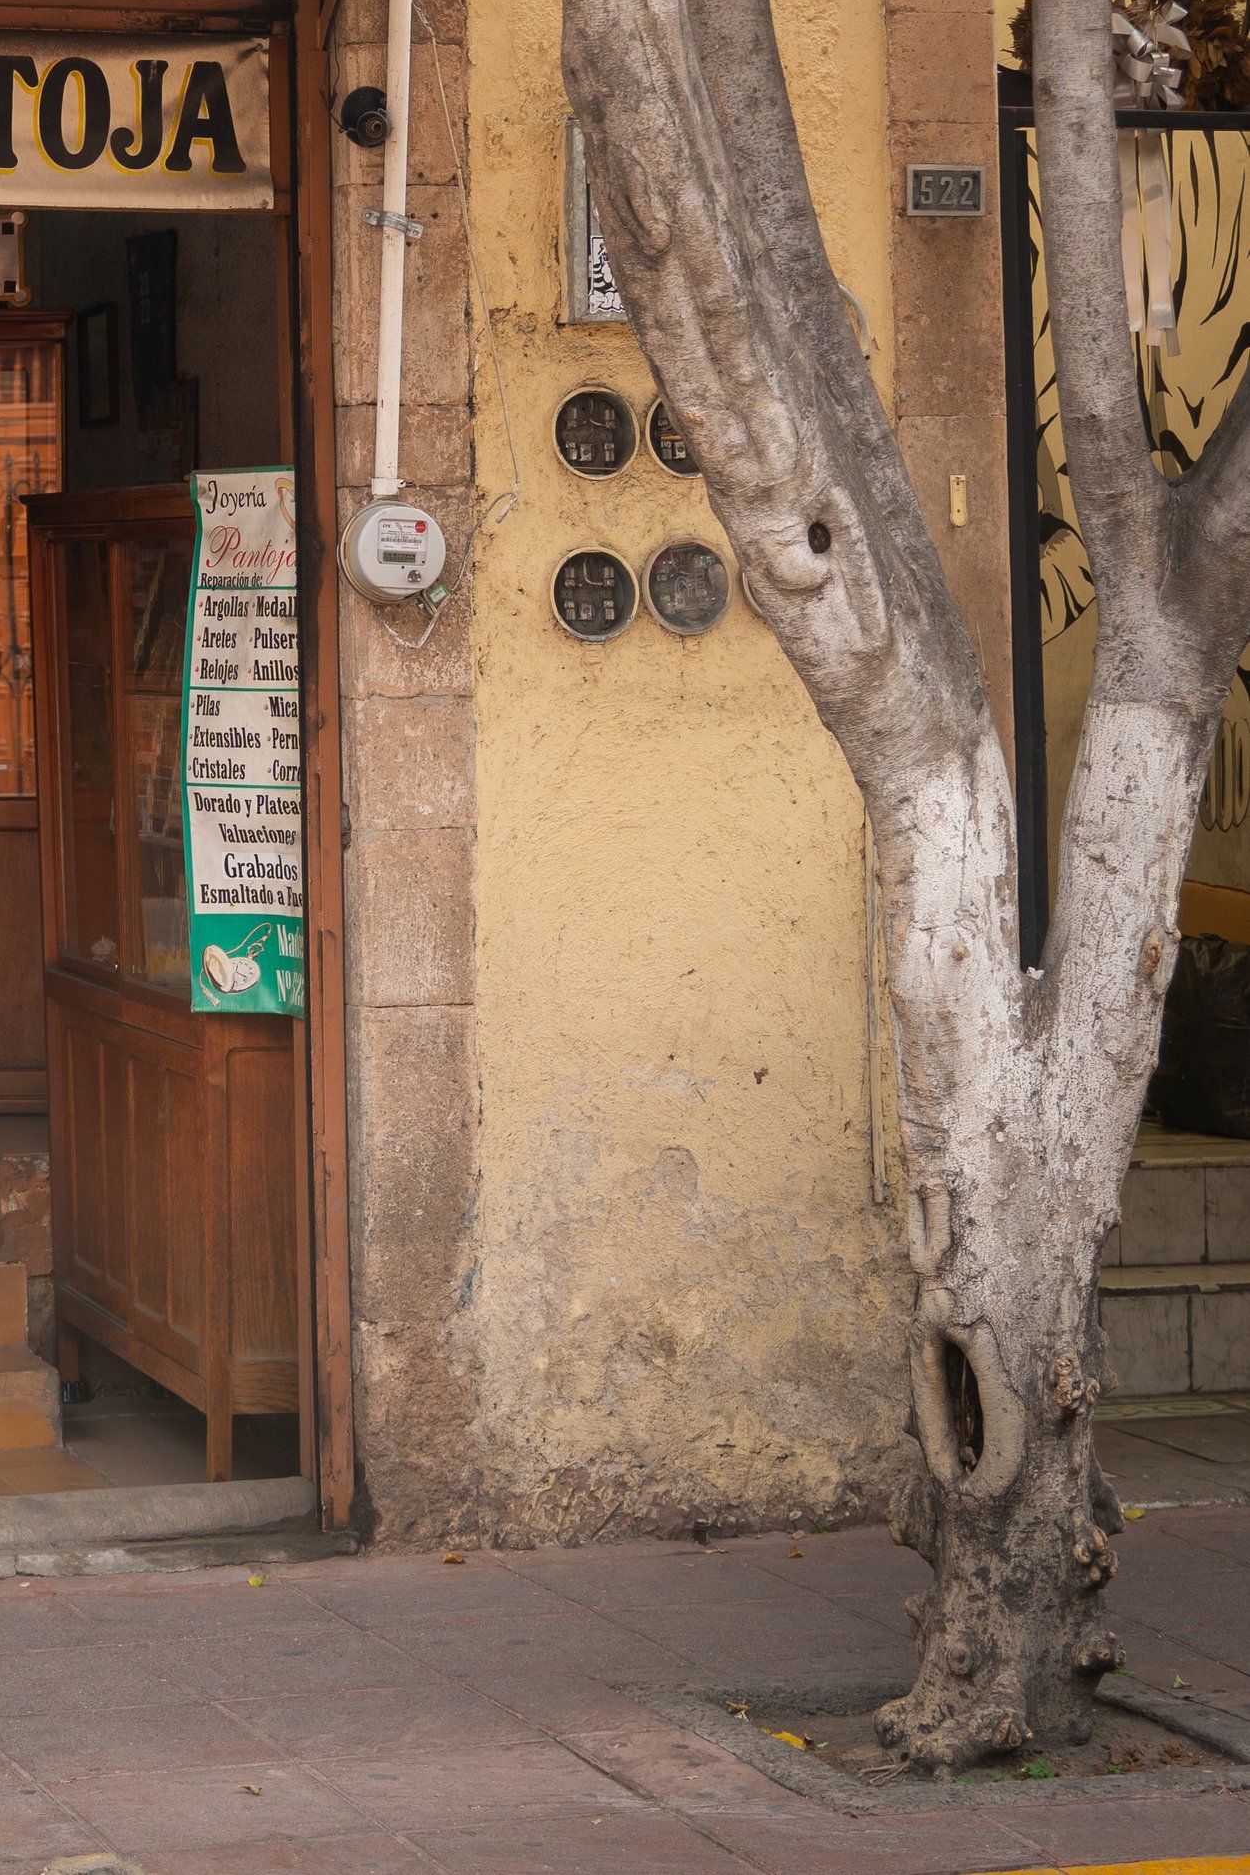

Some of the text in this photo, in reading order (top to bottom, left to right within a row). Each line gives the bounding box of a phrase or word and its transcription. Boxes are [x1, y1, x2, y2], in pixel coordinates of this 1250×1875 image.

[920, 176, 974, 205] 522
[206, 480, 267, 516] Joyería
[201, 571, 263, 591] Reparación de:
[203, 595, 249, 621] Argollas
[201, 626, 237, 649] Aretes
[199, 658, 239, 685] Relojes
[195, 694, 221, 717] Pilas
[193, 726, 261, 749] Extensibles
[192, 757, 246, 780] Cristales
[193, 792, 302, 818] Dorado y Platea
[218, 823, 297, 846] Valuaciones
[223, 852, 298, 882] Grabados
[200, 883, 274, 906] Esmaltado
[277, 889, 285, 905] a
